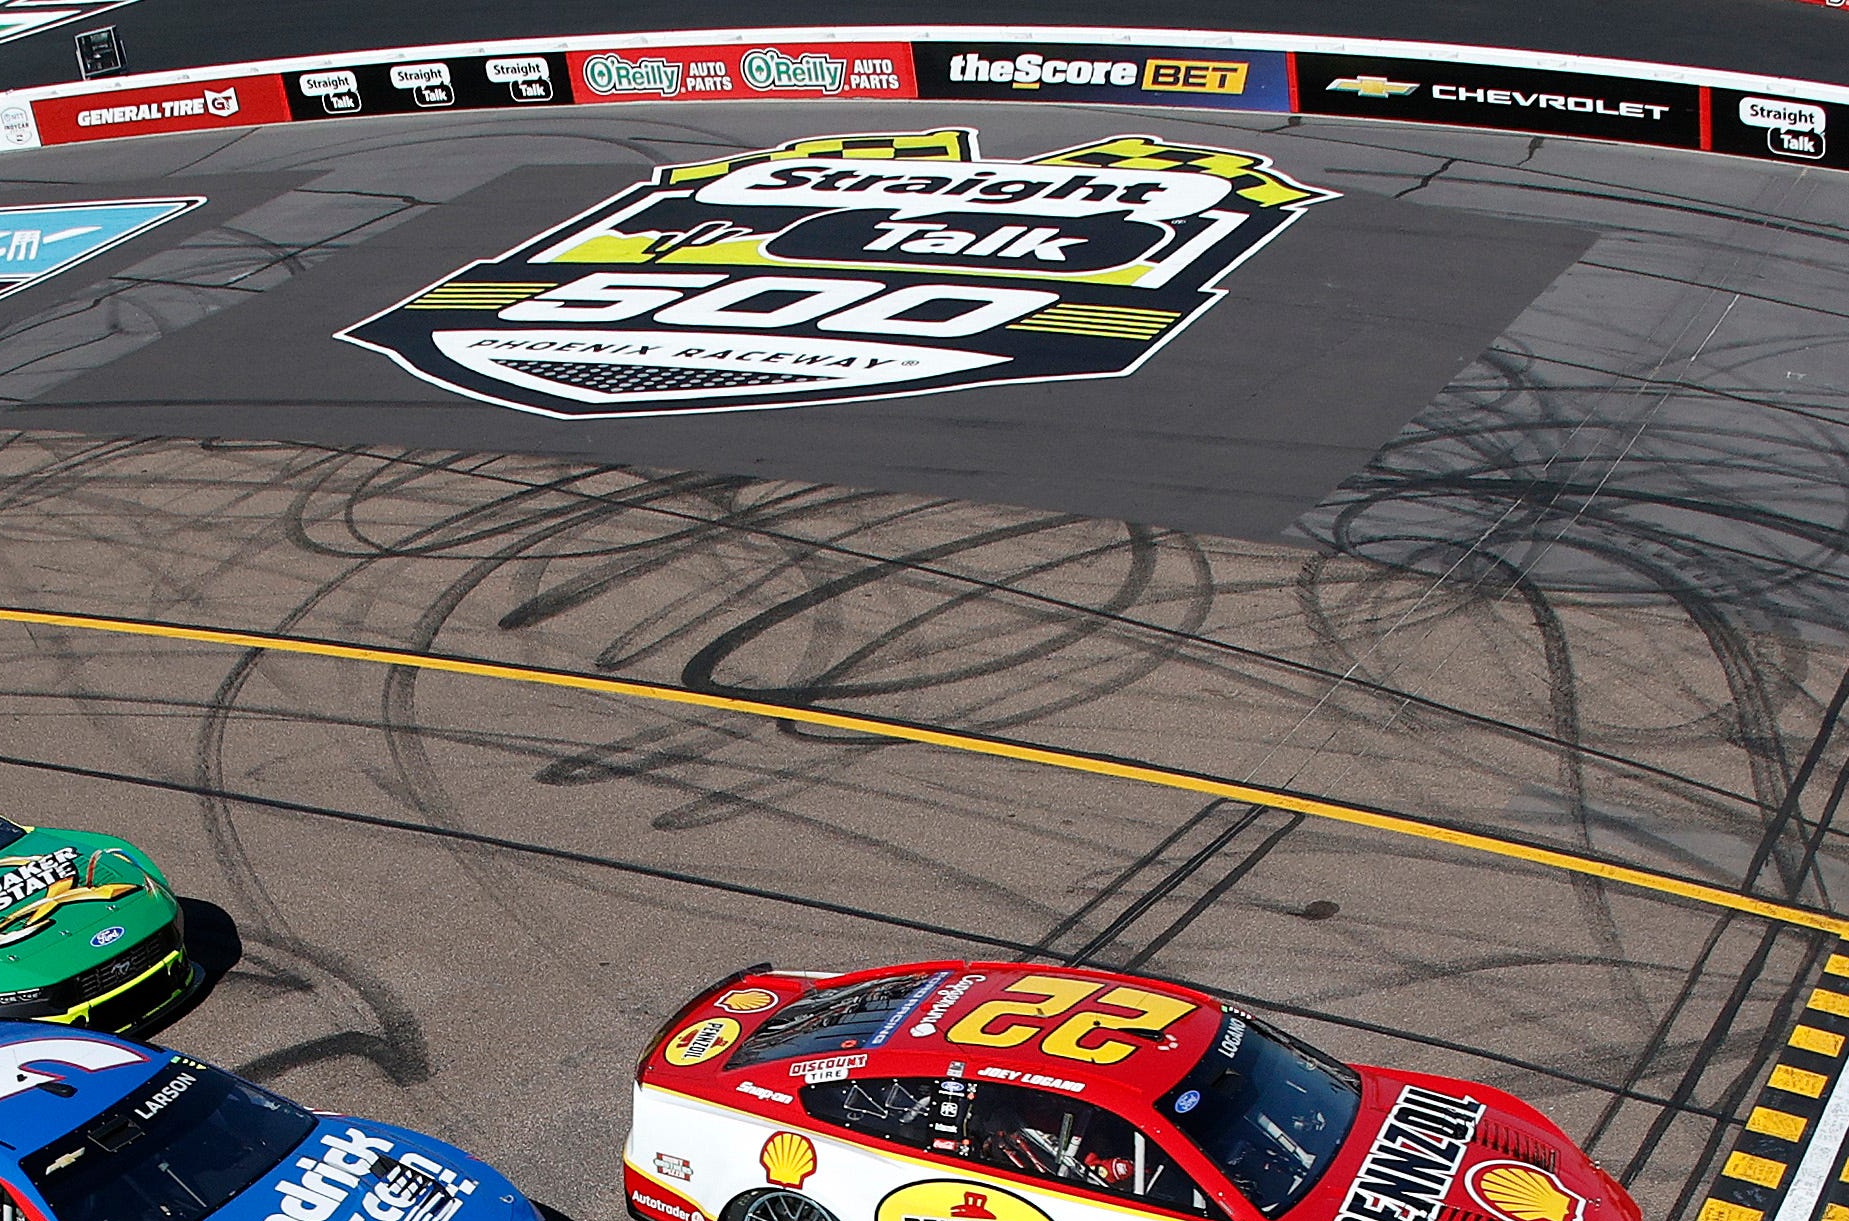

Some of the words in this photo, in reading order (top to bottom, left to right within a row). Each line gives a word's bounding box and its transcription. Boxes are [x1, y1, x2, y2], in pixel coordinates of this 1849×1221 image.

[397, 67, 443, 84] Straight
[492, 61, 542, 79] Straight
[588, 55, 678, 94] O'Reilly
[689, 62, 726, 76] AUTO
[746, 52, 842, 92] O'Reilly
[854, 59, 892, 74] AUTO
[950, 53, 1137, 87] theScore
[1151, 64, 1239, 89] BET
[306, 76, 350, 92] Straight
[421, 88, 448, 103] Talk
[518, 81, 546, 98] Talk
[686, 76, 733, 91] PARTS
[850, 74, 900, 90] PARTS
[77, 103, 163, 128] GENERAL
[162, 98, 205, 119] TIRE
[330, 94, 354, 110] Talk
[1432, 84, 1670, 121] CHEVROLET
[1750, 103, 1816, 125] Straight
[1780, 133, 1815, 154] Talk
[754, 166, 1173, 207] Straight
[863, 220, 1088, 262] Talk
[498, 271, 1059, 338] 500
[469, 339, 657, 361] PHOENIX
[672, 346, 900, 374] RACEWAY
[870, 998, 918, 1046] RACING
[945, 974, 1198, 1065] 22
[685, 1021, 725, 1060] PENNZOIL
[1217, 1017, 1246, 1059] LOGANO
[790, 1054, 867, 1077] DISCOUNT
[810, 1070, 843, 1081] TIRE
[735, 1081, 793, 1105] Snap-on
[977, 1066, 1022, 1082] JOEY
[1020, 1073, 1086, 1093] LOGANO
[134, 1072, 198, 1121] LARSON
[632, 1190, 691, 1221] Autotrader
